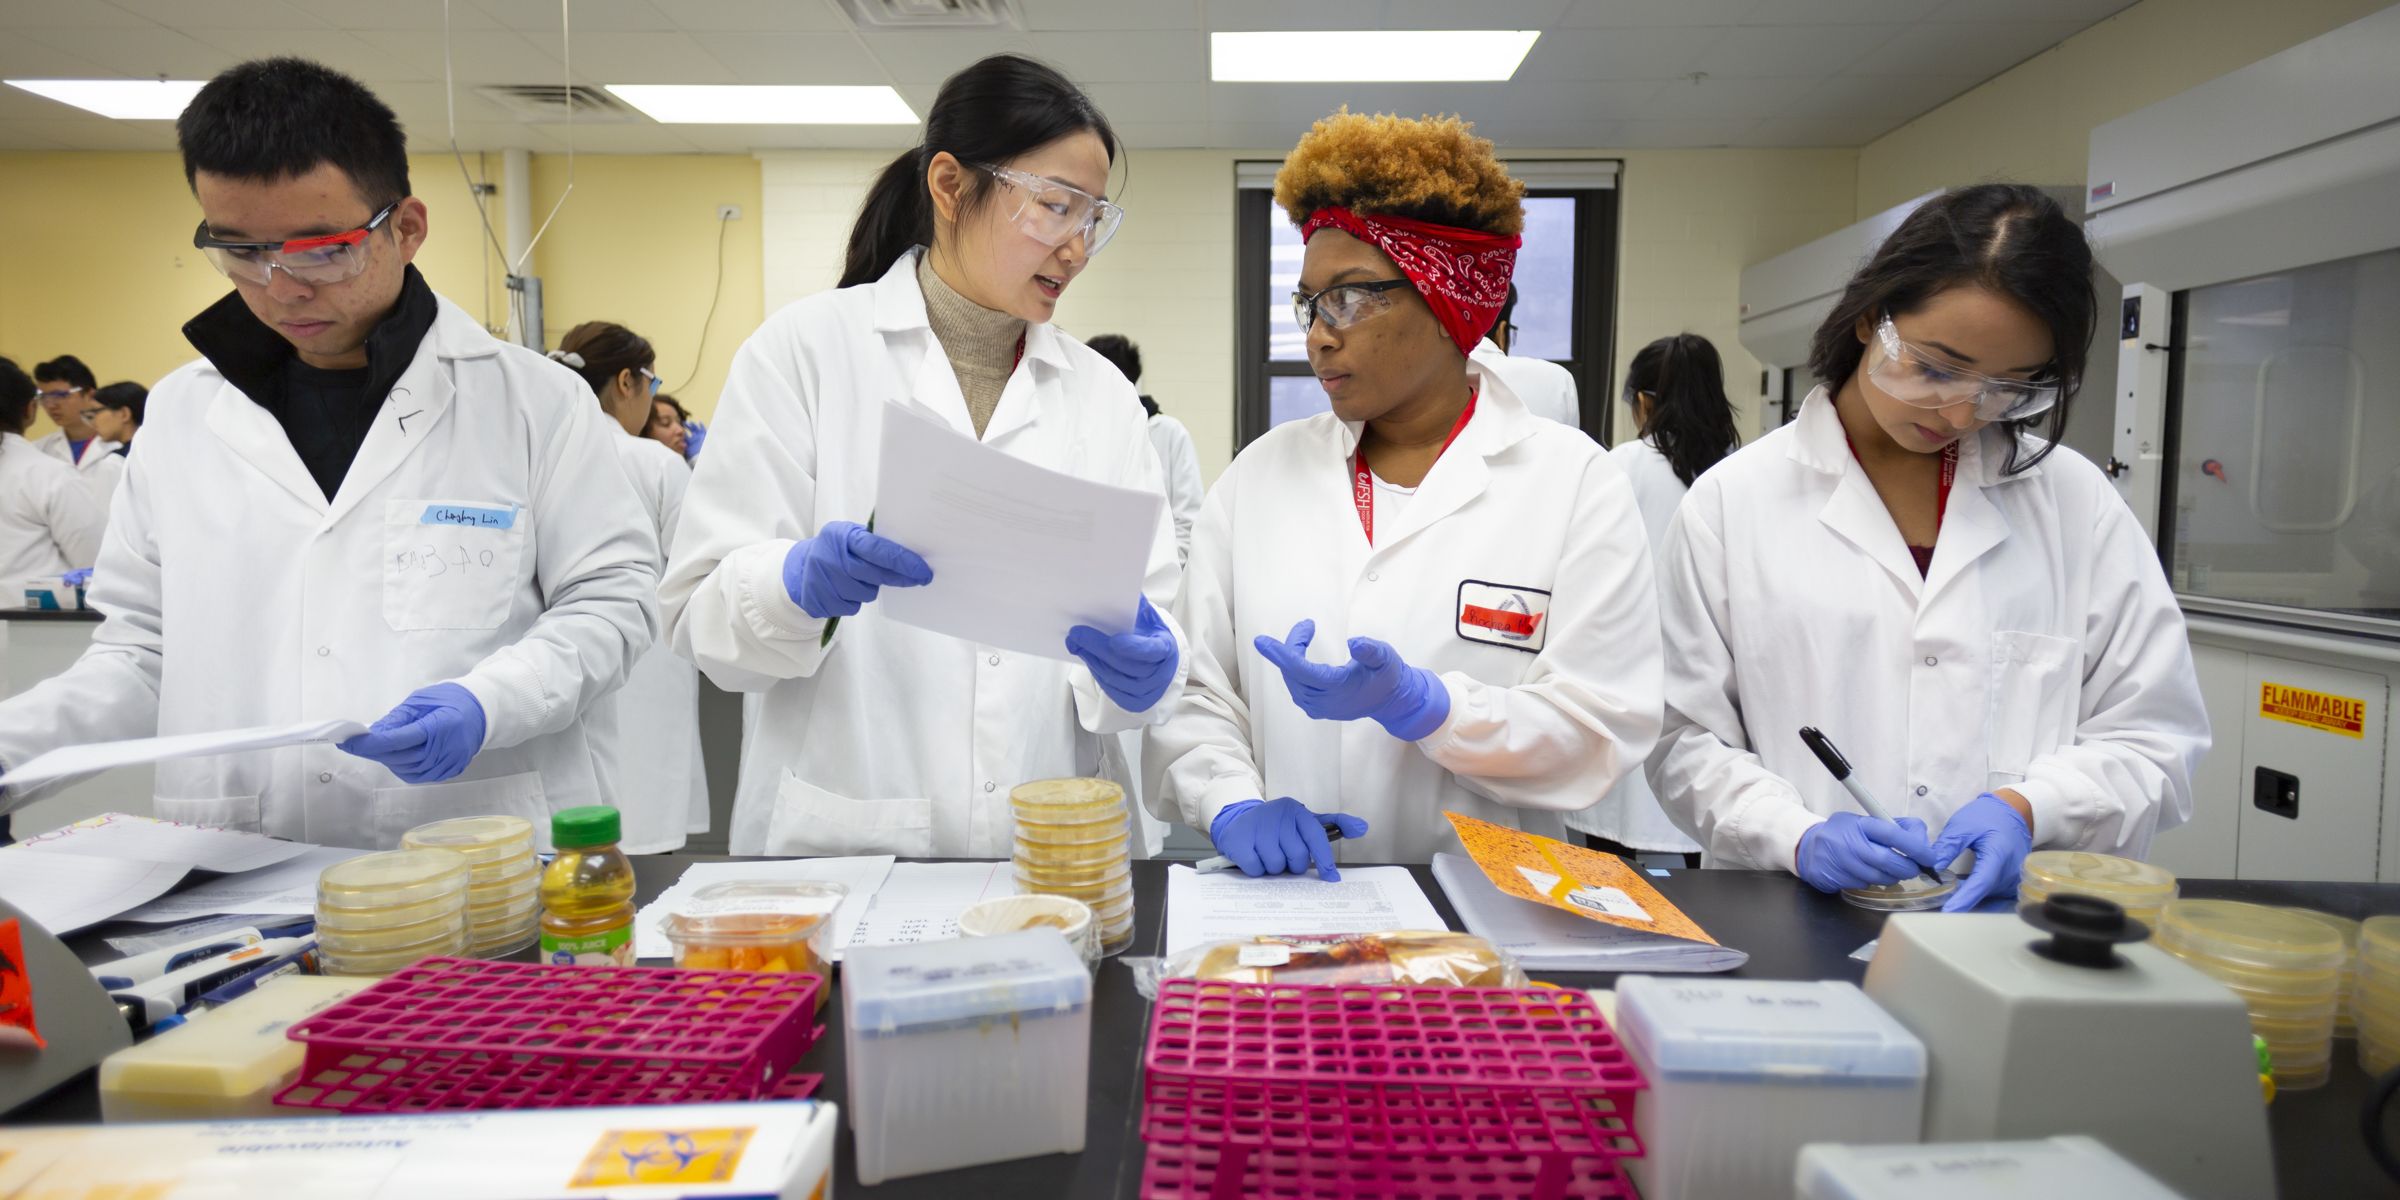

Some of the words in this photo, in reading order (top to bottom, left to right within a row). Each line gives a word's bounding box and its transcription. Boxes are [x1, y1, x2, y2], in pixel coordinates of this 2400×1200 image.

[2263, 685, 2363, 722] FLAMMABLE
[2273, 706, 2297, 718] KEEP
[2298, 711, 2320, 723] FIRE
[2321, 715, 2348, 728] AWAY
[217, 1139, 412, 1156] Autoclavable
